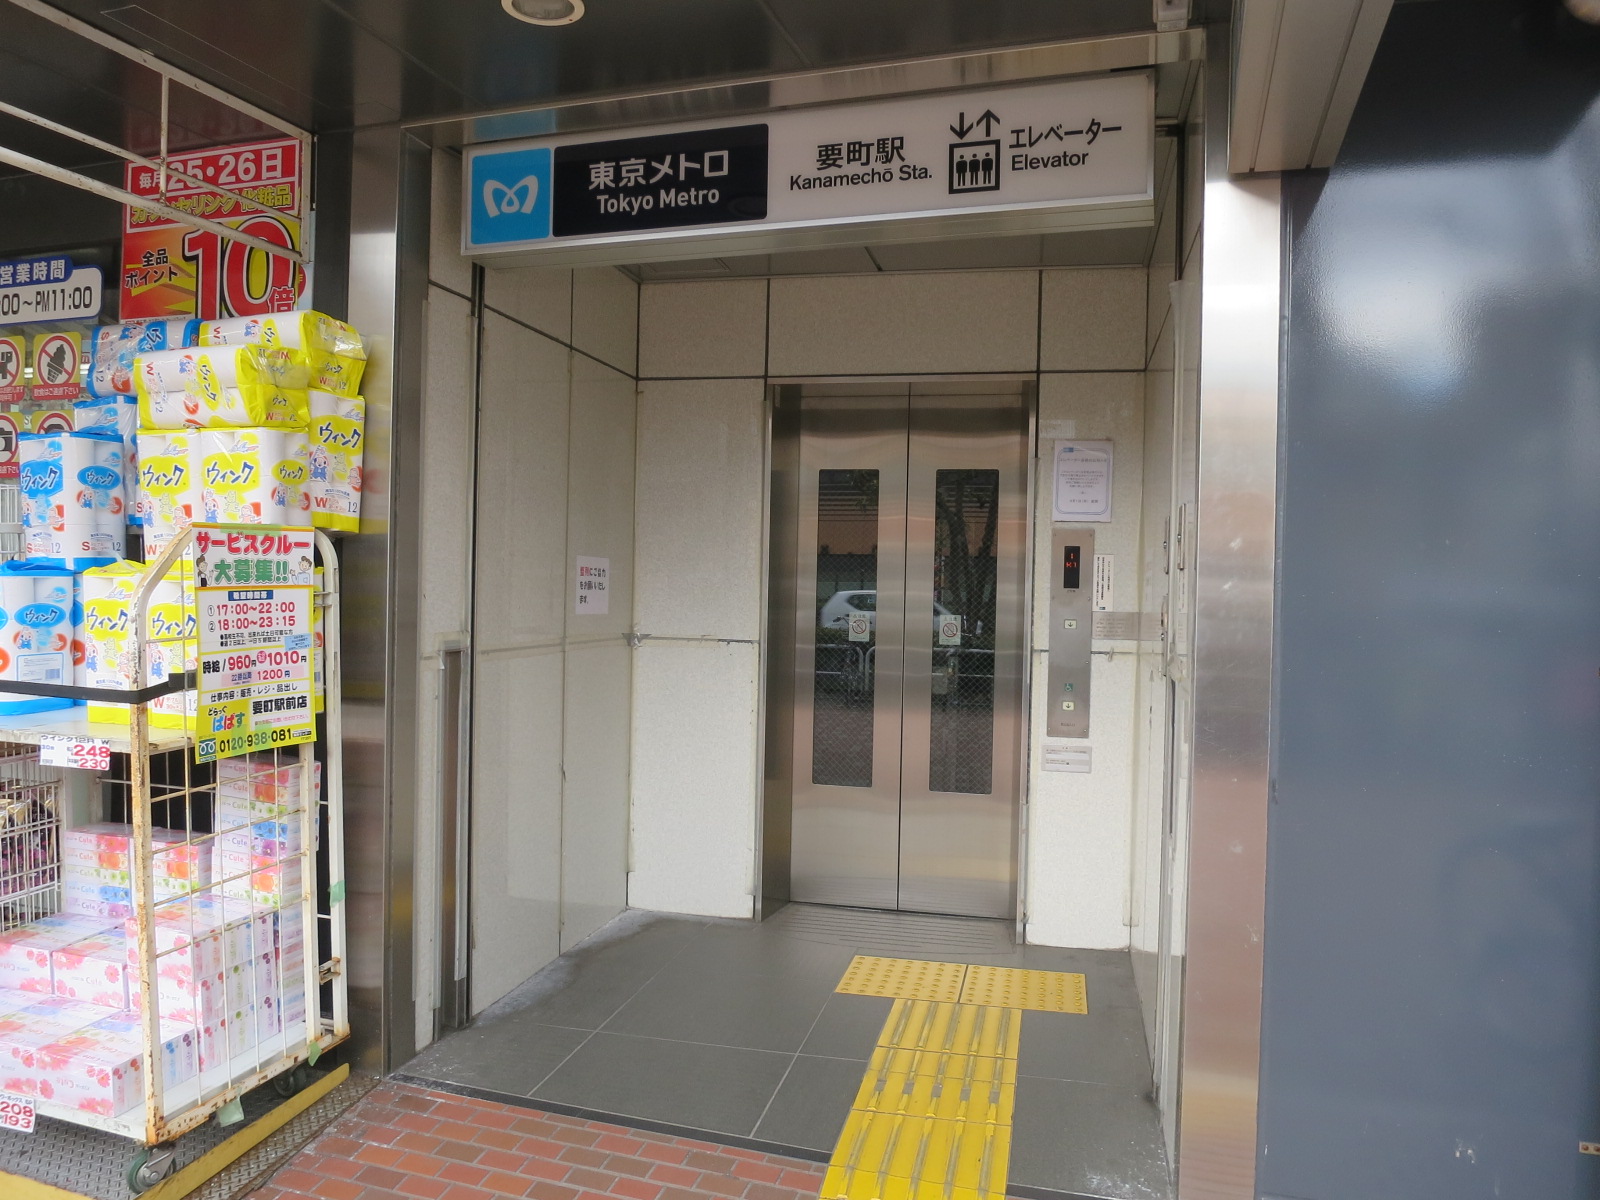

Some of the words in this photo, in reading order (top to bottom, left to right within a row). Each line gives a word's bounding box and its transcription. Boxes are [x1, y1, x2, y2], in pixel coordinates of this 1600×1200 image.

[1009, 118, 1122, 149] エレベーター
[816, 137, 905, 170] 要町駅
[1011, 150, 1089, 172] Elevator
[588, 149, 730, 191] 東京メトロ
[789, 167, 894, 191] Kanamechō
[898, 164, 934, 182] Sta.
[596, 193, 653, 216] Tokyo
[658, 187, 721, 209] Metro
[142, 248, 169, 268] 全品
[0, 259, 66, 286] 営業時間
[125, 265, 179, 290] ポイント
[319, 422, 363, 449] ウィング
[21, 466, 59, 491] ウィング
[85, 469, 115, 486] ウィング
[142, 464, 185, 488] ウィング
[206, 461, 255, 488] ウィング
[280, 464, 304, 480] ウィング
[196, 531, 311, 556] サービスクルー
[25, 608, 59, 624] ウィング
[86, 606, 129, 632] ウィング
[252, 696, 307, 715] 要町駅前店
[73, 743, 111, 758] 248
[79, 757, 109, 770] 230
[3, 1114, 31, 1129] 193
